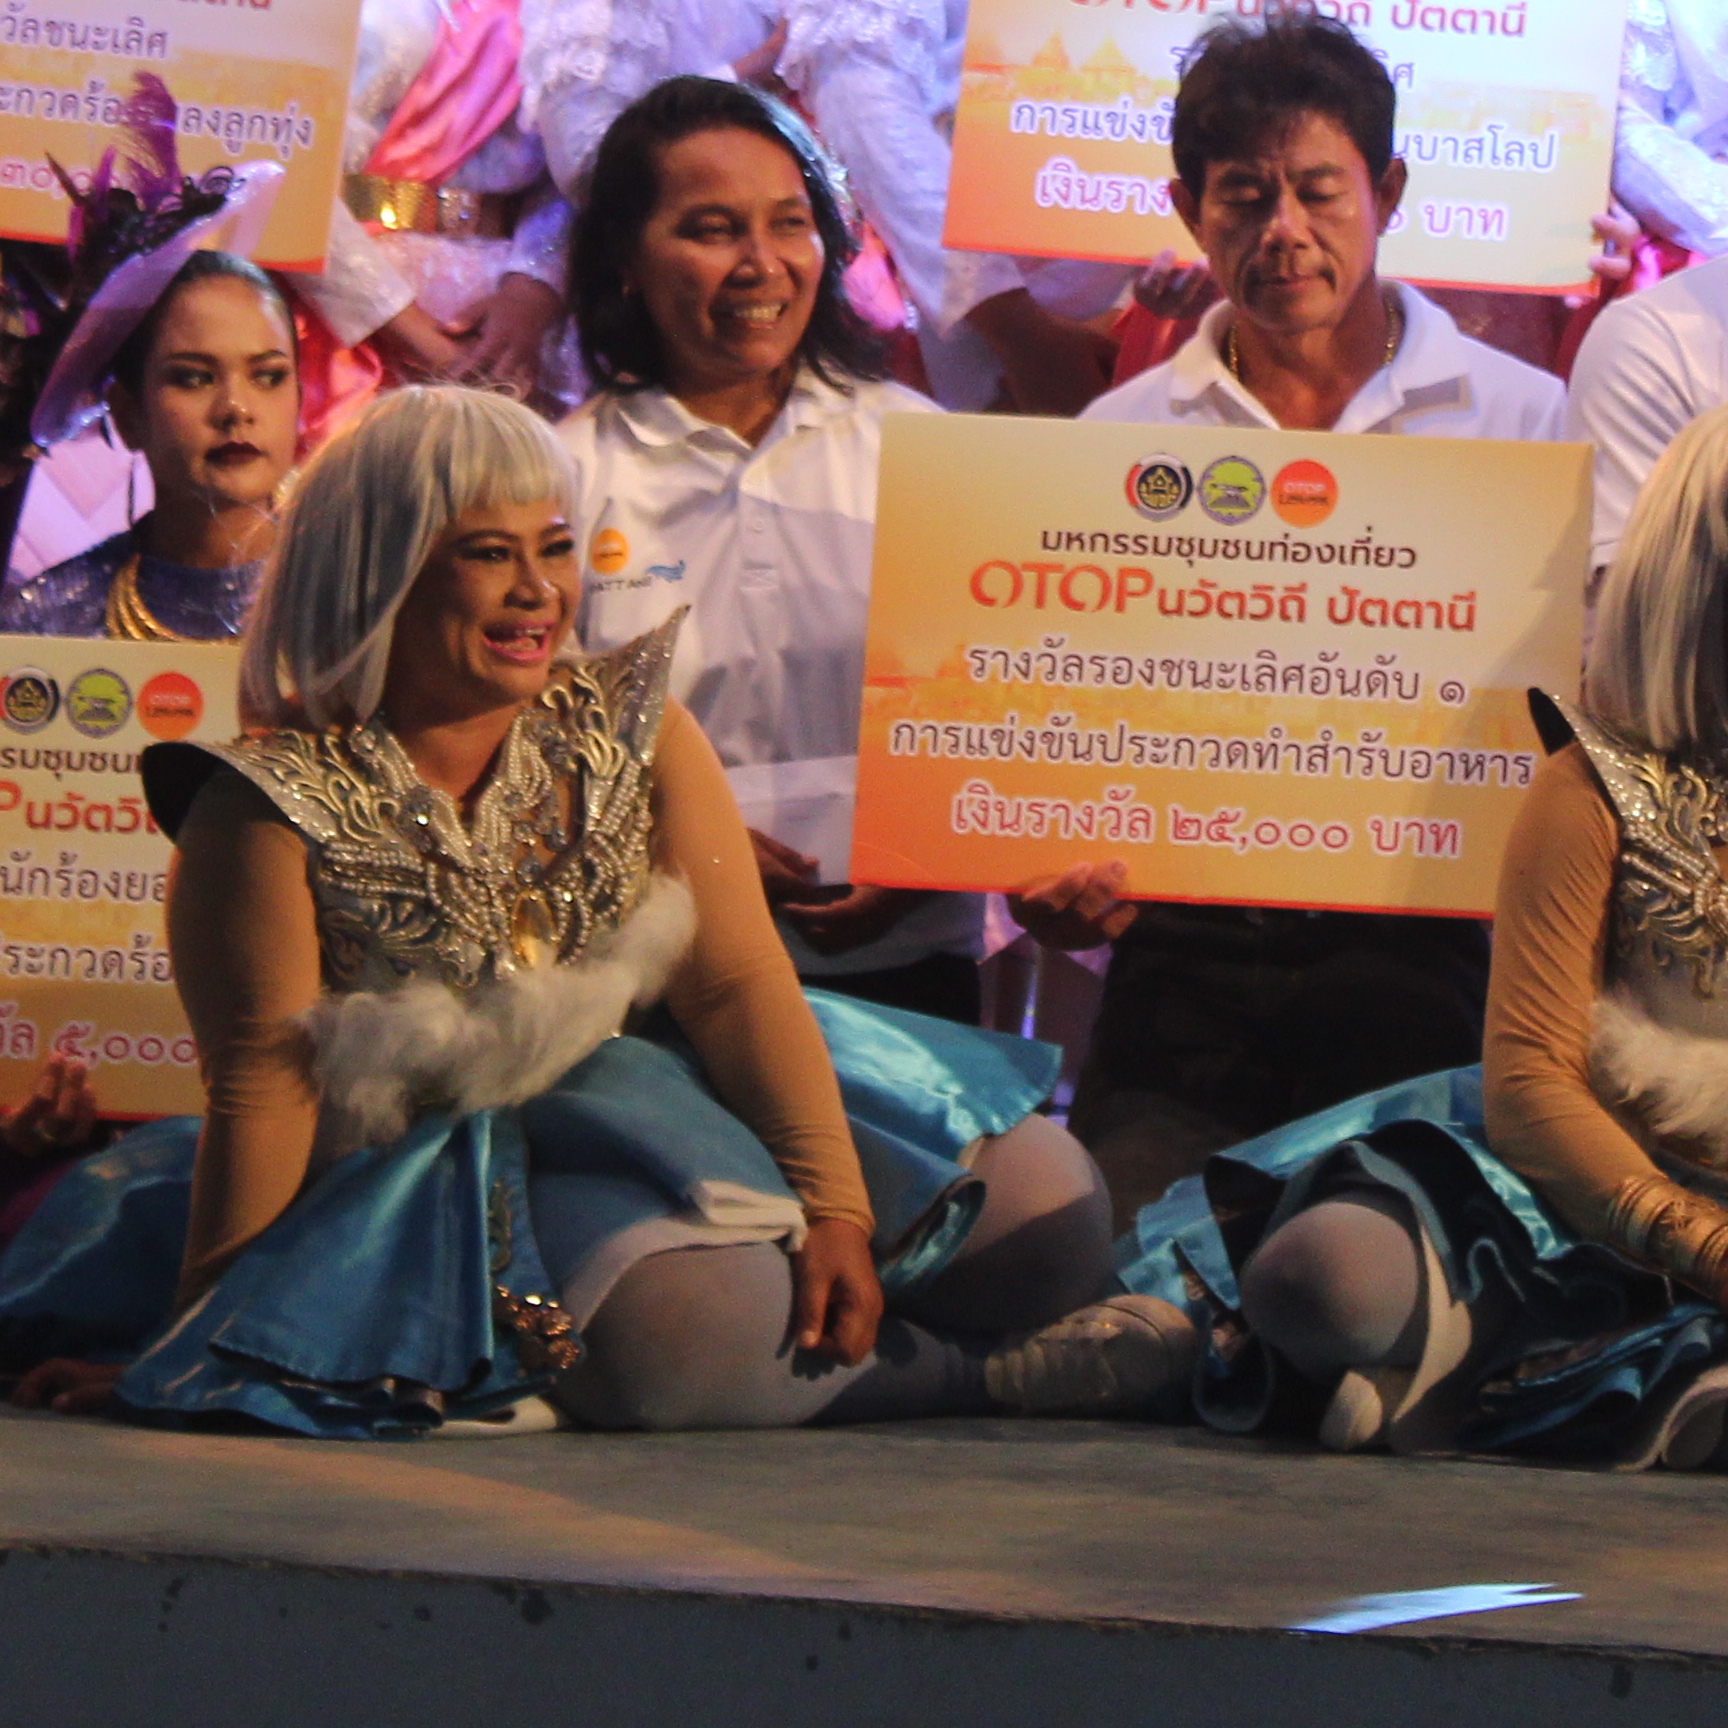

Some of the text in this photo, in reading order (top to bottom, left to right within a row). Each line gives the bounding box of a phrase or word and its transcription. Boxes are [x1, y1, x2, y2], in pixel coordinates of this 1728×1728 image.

[1040, 161, 1173, 210] เงินราง
[1424, 204, 1504, 236] บาท
[1040, 526, 1417, 571] มหกรรมชุมชนท่องเที่ยว
[970, 560, 1476, 634] OTOP นวัตวิถี ปัตตานี
[969, 637, 1420, 702] รางวัลรองชนะเลิศอันดับ
[892, 717, 1533, 785] การแข่งขันประกวดทำสำรับอาหาร
[953, 785, 1458, 855] เงินรางวัล ๒๕,๐๐๐ บาท
